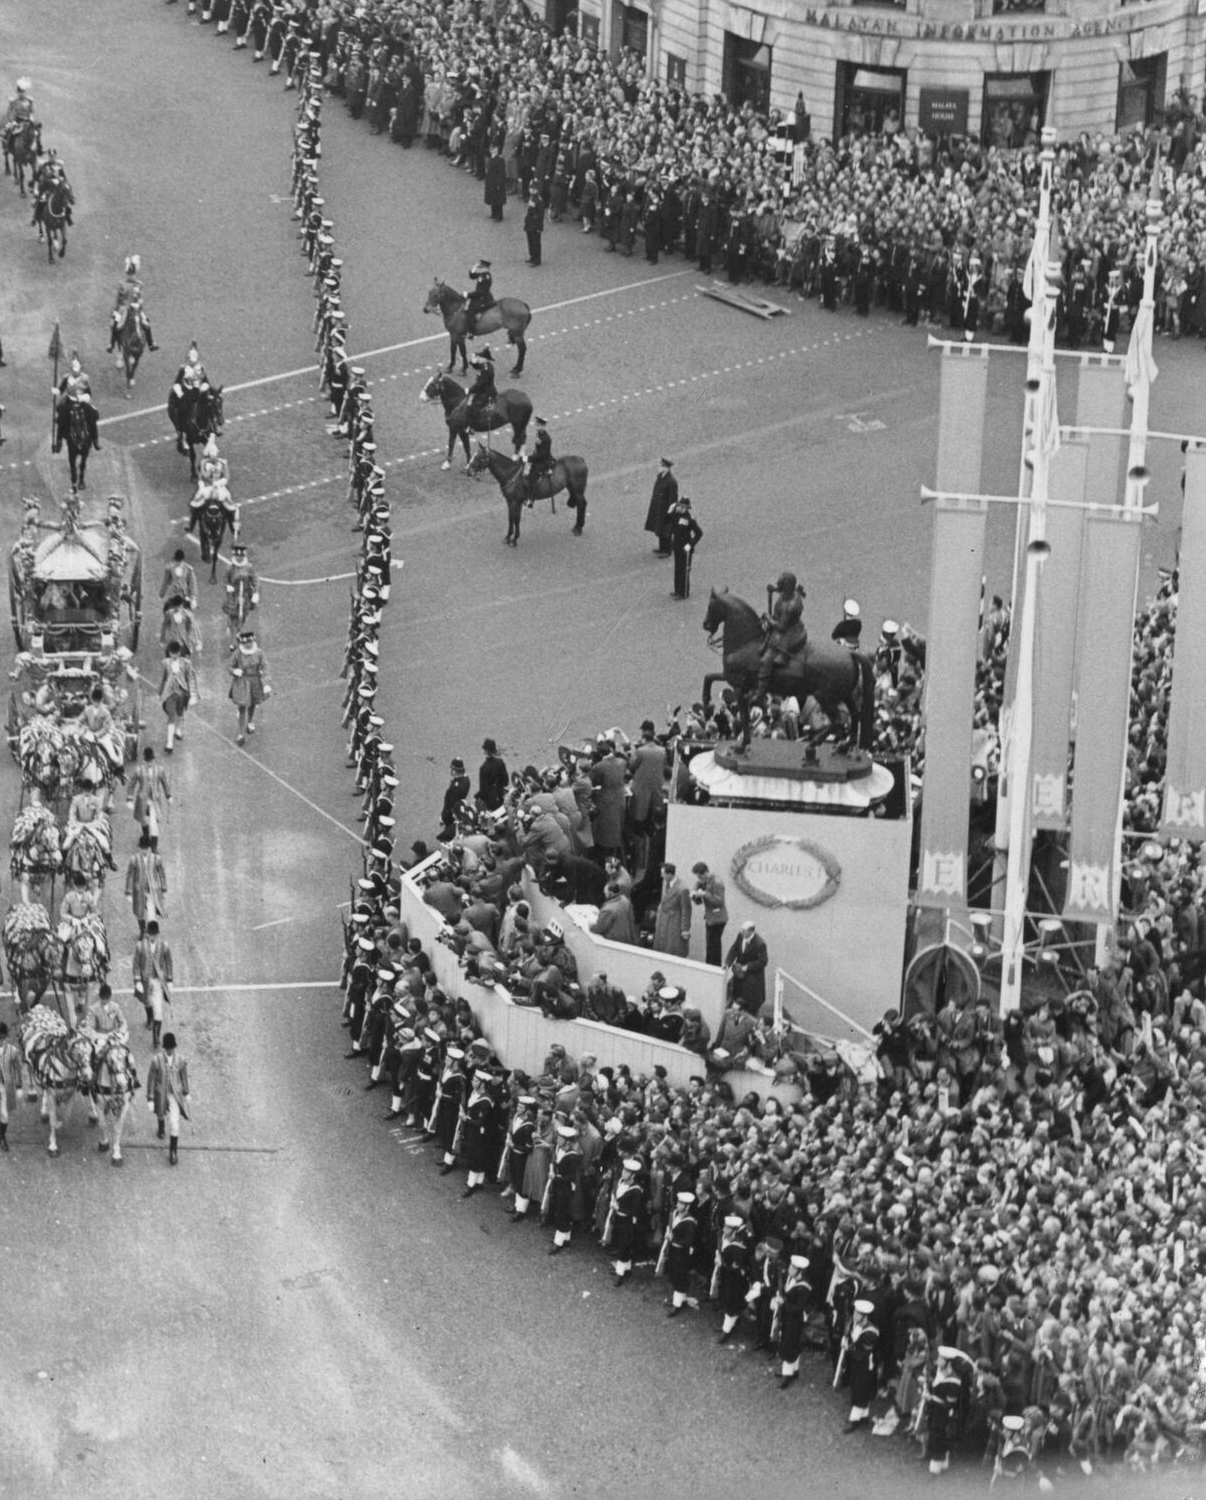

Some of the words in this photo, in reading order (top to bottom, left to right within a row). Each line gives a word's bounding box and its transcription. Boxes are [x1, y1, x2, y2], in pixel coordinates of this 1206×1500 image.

[806, 8, 897, 33] MALAYAN
[916, 21, 1055, 42] INFORMATION
[1071, 15, 1136, 38] AGENCY
[931, 101, 957, 110] MALAYA
[1035, 780, 1052, 808] E
[747, 860, 813, 879] CHARLES
[935, 859, 954, 887] E
[1081, 873, 1100, 901] R
